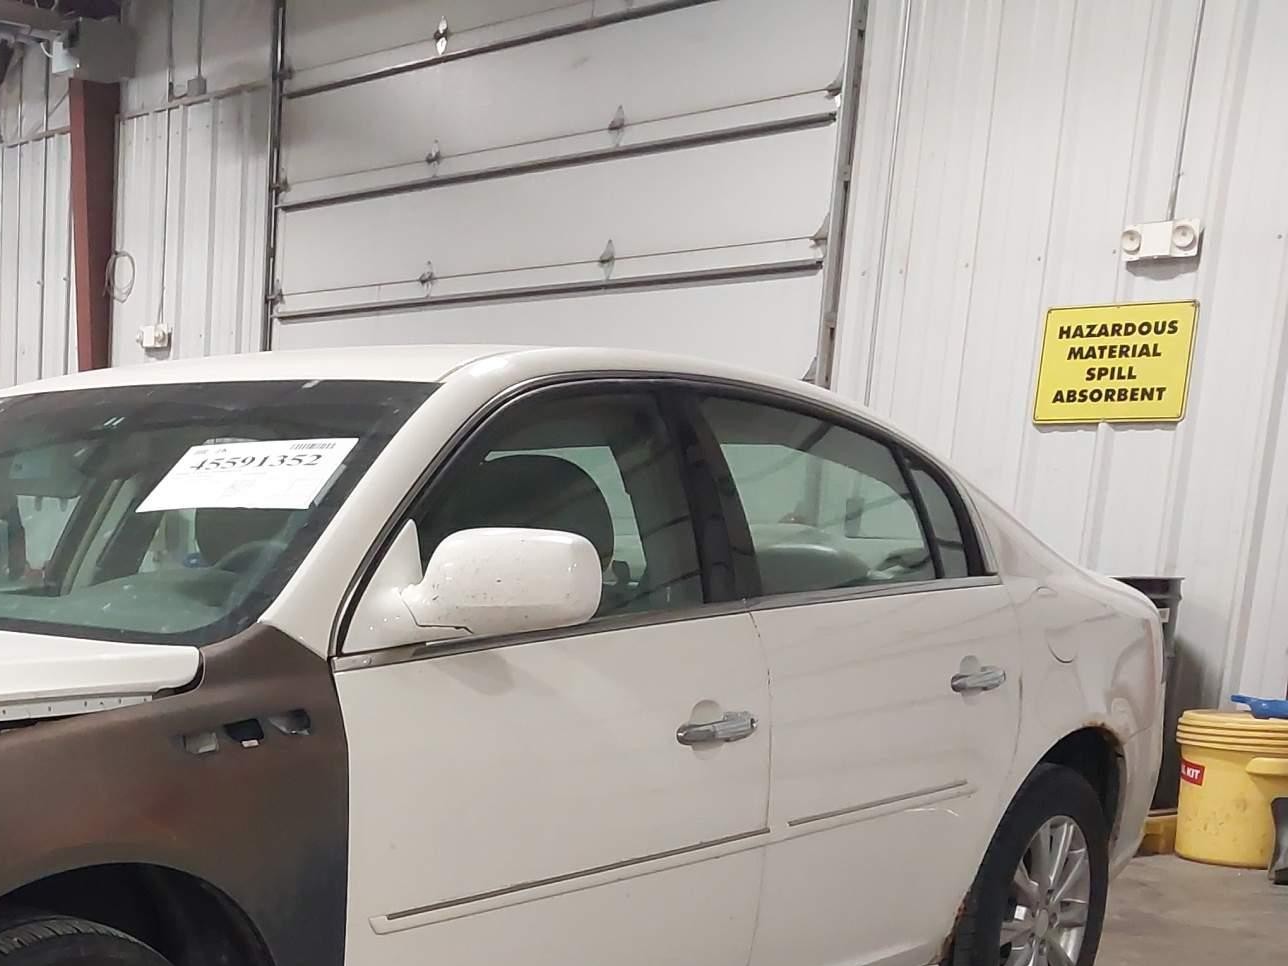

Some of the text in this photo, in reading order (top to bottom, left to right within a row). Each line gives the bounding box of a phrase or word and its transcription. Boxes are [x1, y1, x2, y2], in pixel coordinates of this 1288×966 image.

[1059, 321, 1178, 339] HAZARDOUS
[1067, 344, 1162, 360] MATERIAL
[1085, 367, 1137, 380] SPILL
[1052, 387, 1167, 403] ABSORBENT
[190, 453, 323, 471] 45591352
